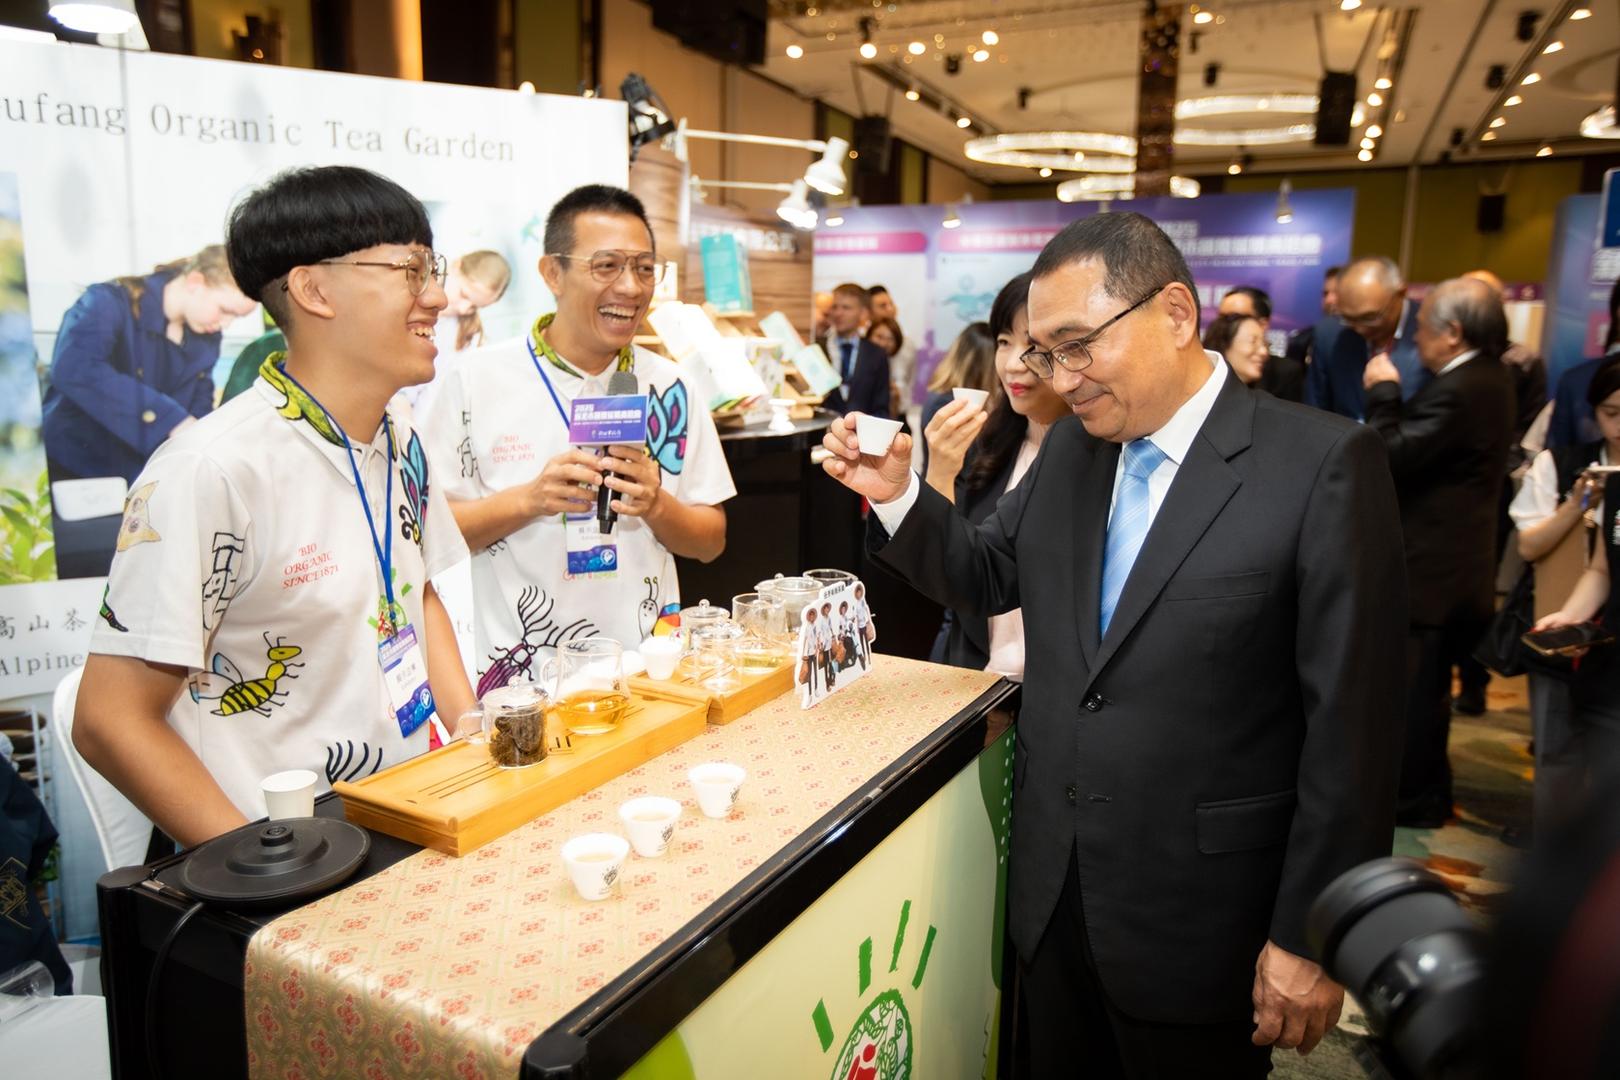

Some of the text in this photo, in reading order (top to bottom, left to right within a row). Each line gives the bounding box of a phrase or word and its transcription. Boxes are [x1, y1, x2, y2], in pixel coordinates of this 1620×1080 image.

[0, 93, 515, 162] ufang Organic Tea Garden
[298, 543, 317, 556] BIO
[284, 551, 332, 576] ORGANIC
